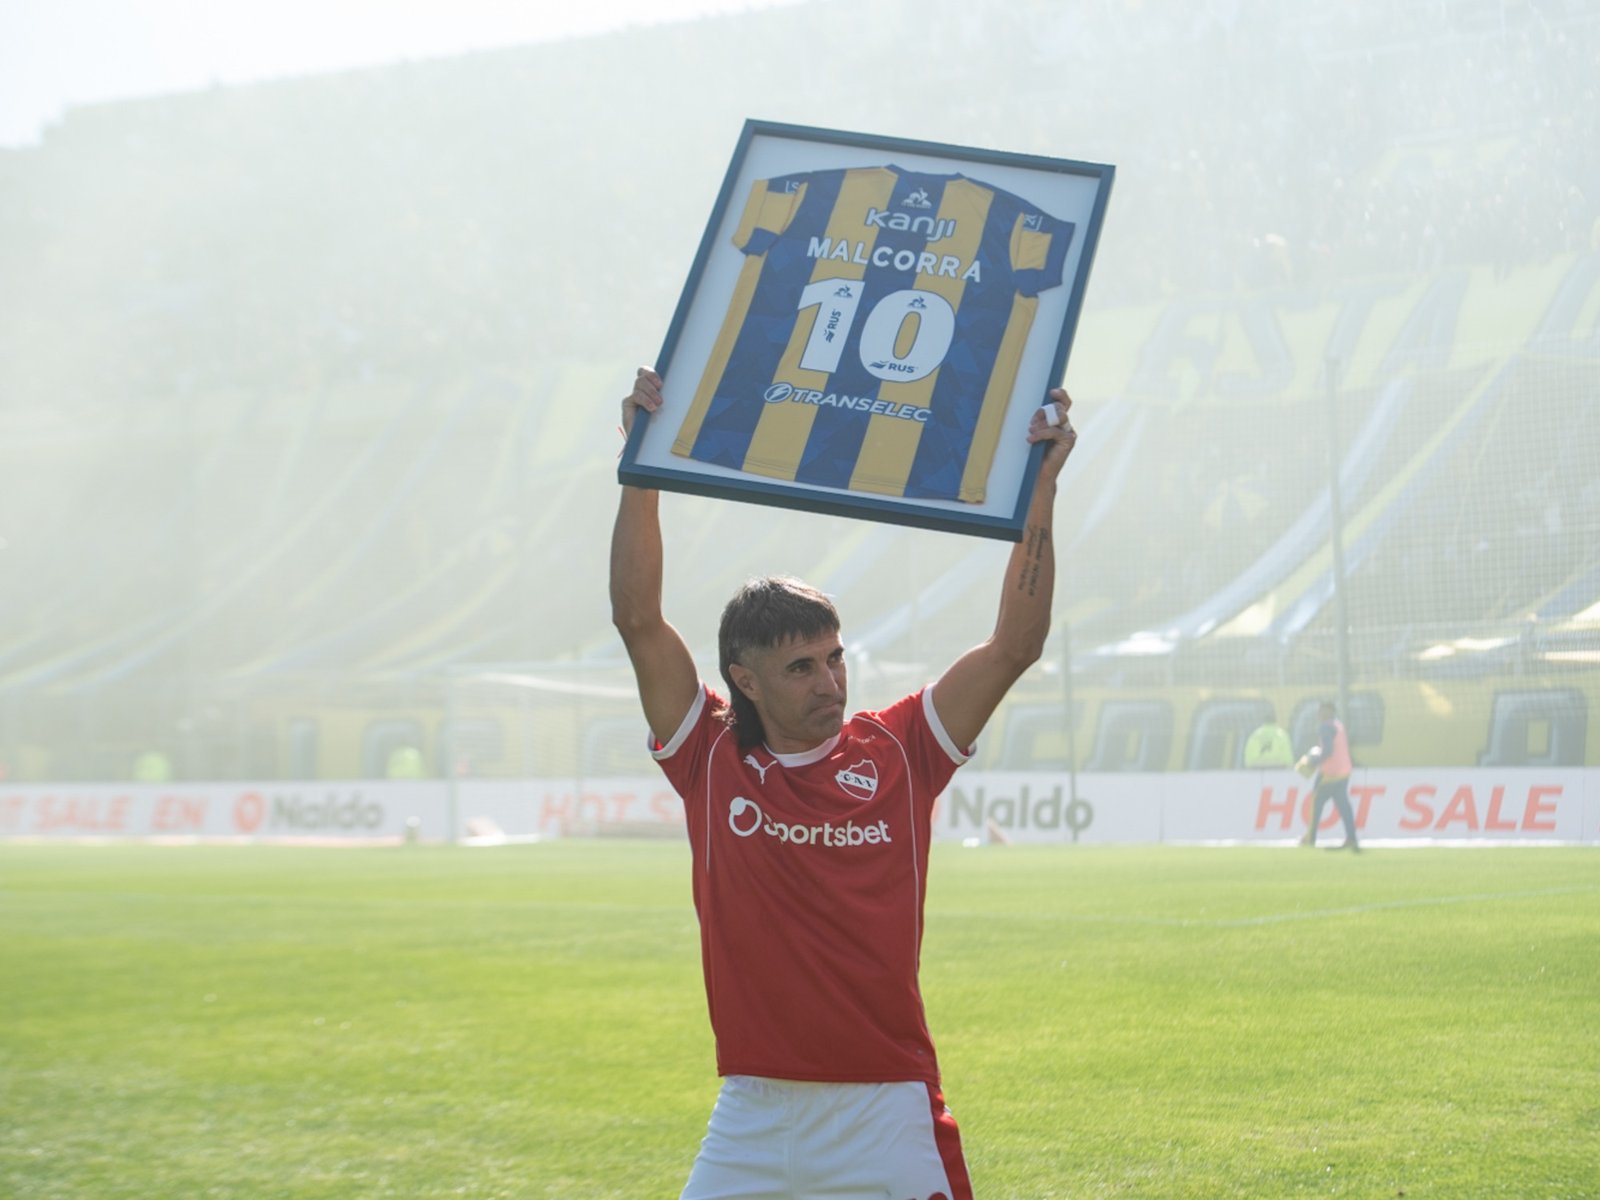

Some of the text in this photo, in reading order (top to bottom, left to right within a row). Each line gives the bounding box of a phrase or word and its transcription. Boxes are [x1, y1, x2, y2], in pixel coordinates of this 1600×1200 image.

[806, 236, 982, 283] MALCORRA
[797, 278, 956, 383] 10
[827, 310, 841, 329] RUS
[888, 362, 915, 374] RUS
[792, 388, 932, 422] TRANSELEC
[272, 790, 384, 831] Naldo
[951, 784, 1095, 832] Naldo
[1398, 784, 1564, 832] SALE
